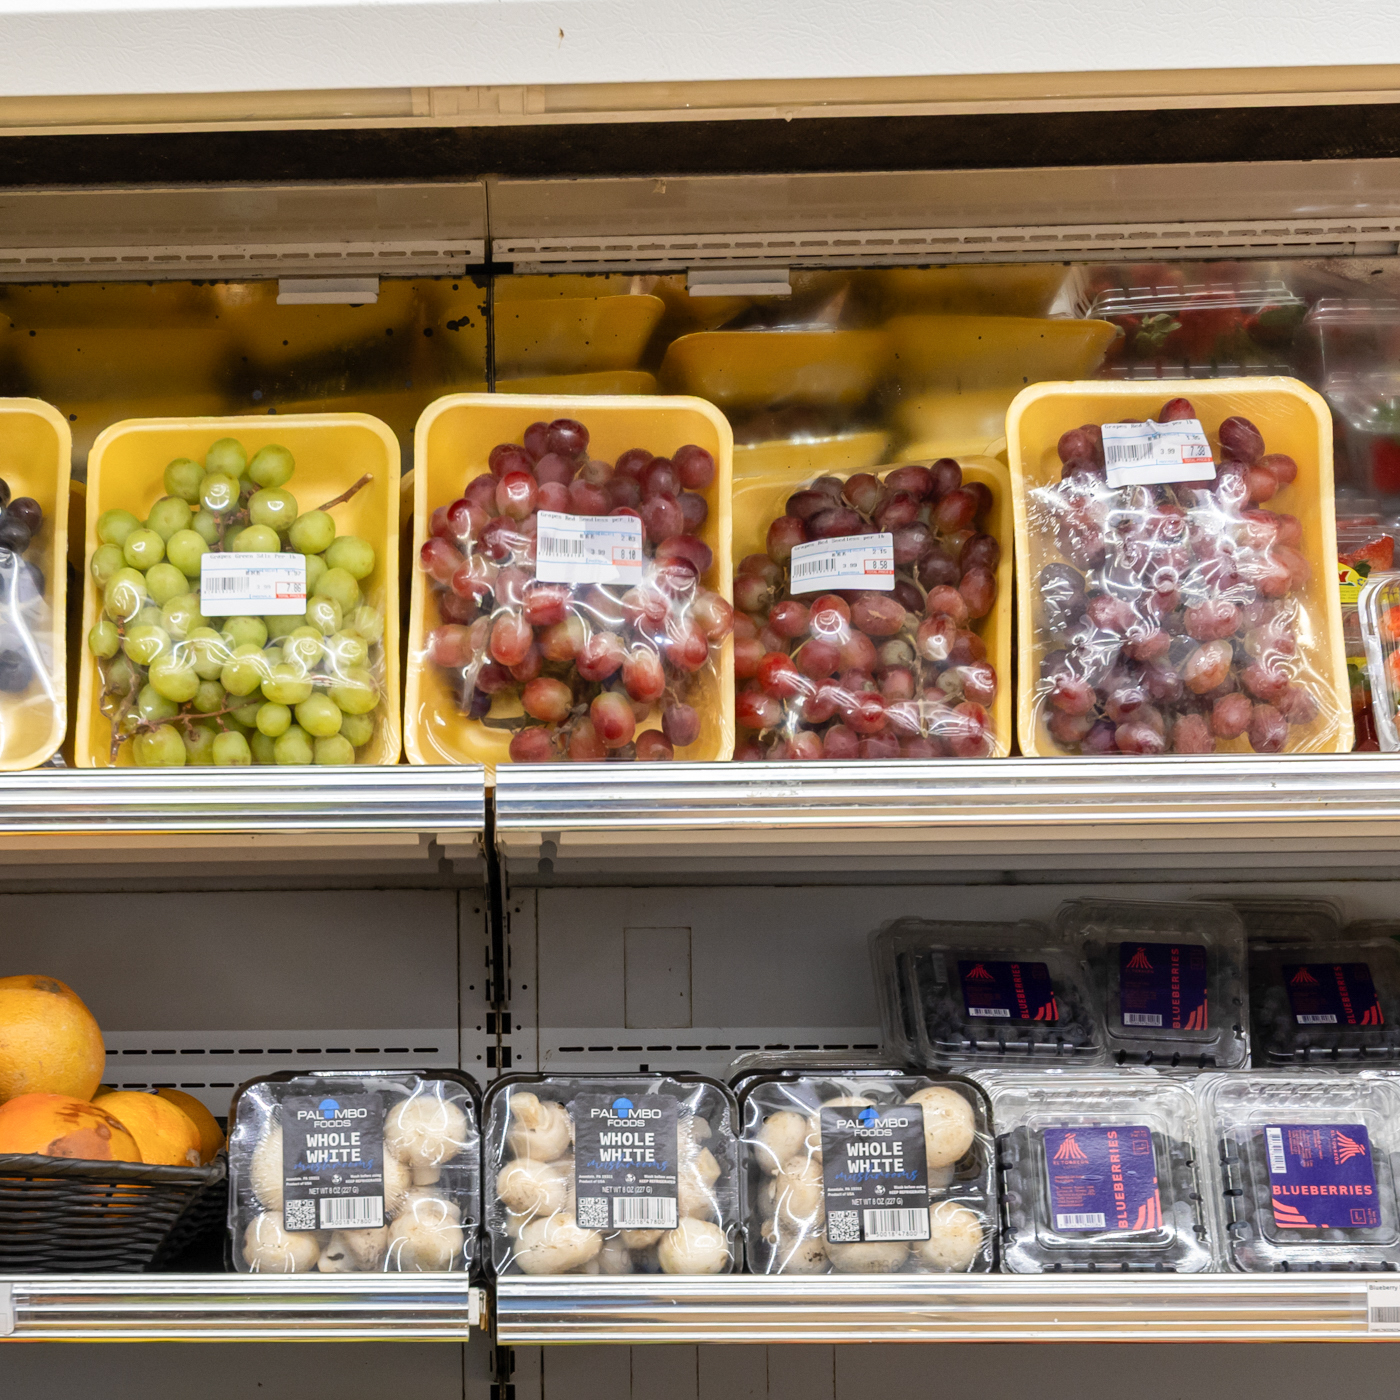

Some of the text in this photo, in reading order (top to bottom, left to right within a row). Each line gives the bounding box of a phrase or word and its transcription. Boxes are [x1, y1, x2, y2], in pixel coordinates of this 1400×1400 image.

[872, 560, 888, 570] 8.58
[1011, 964, 1030, 1019] BLUEBERRIES
[1171, 948, 1180, 1029] BLUEBERRIES
[1337, 966, 1356, 1025] BLUEBERRIES
[297, 1106, 367, 1120] PALMBO
[591, 1106, 662, 1118] PALMBO
[314, 1119, 351, 1128] FOODS
[607, 1119, 646, 1127] FOODS
[836, 1116, 908, 1129] PALMBO
[306, 1132, 361, 1147] WHOLE
[600, 1132, 655, 1146] WHOLE
[854, 1129, 893, 1137] FOODS
[306, 1148, 361, 1163] WHITE
[600, 1148, 655, 1162] WHITE
[846, 1142, 903, 1156] WHOLE
[294, 1155, 374, 1172] mushrooms
[587, 1155, 668, 1171] mushrooms
[847, 1158, 904, 1173] WHITE
[835, 1165, 918, 1182] mushrooms
[1107, 1131, 1129, 1228] BLUEBERRIES
[1272, 1185, 1373, 1195] BLUEBERRIES
